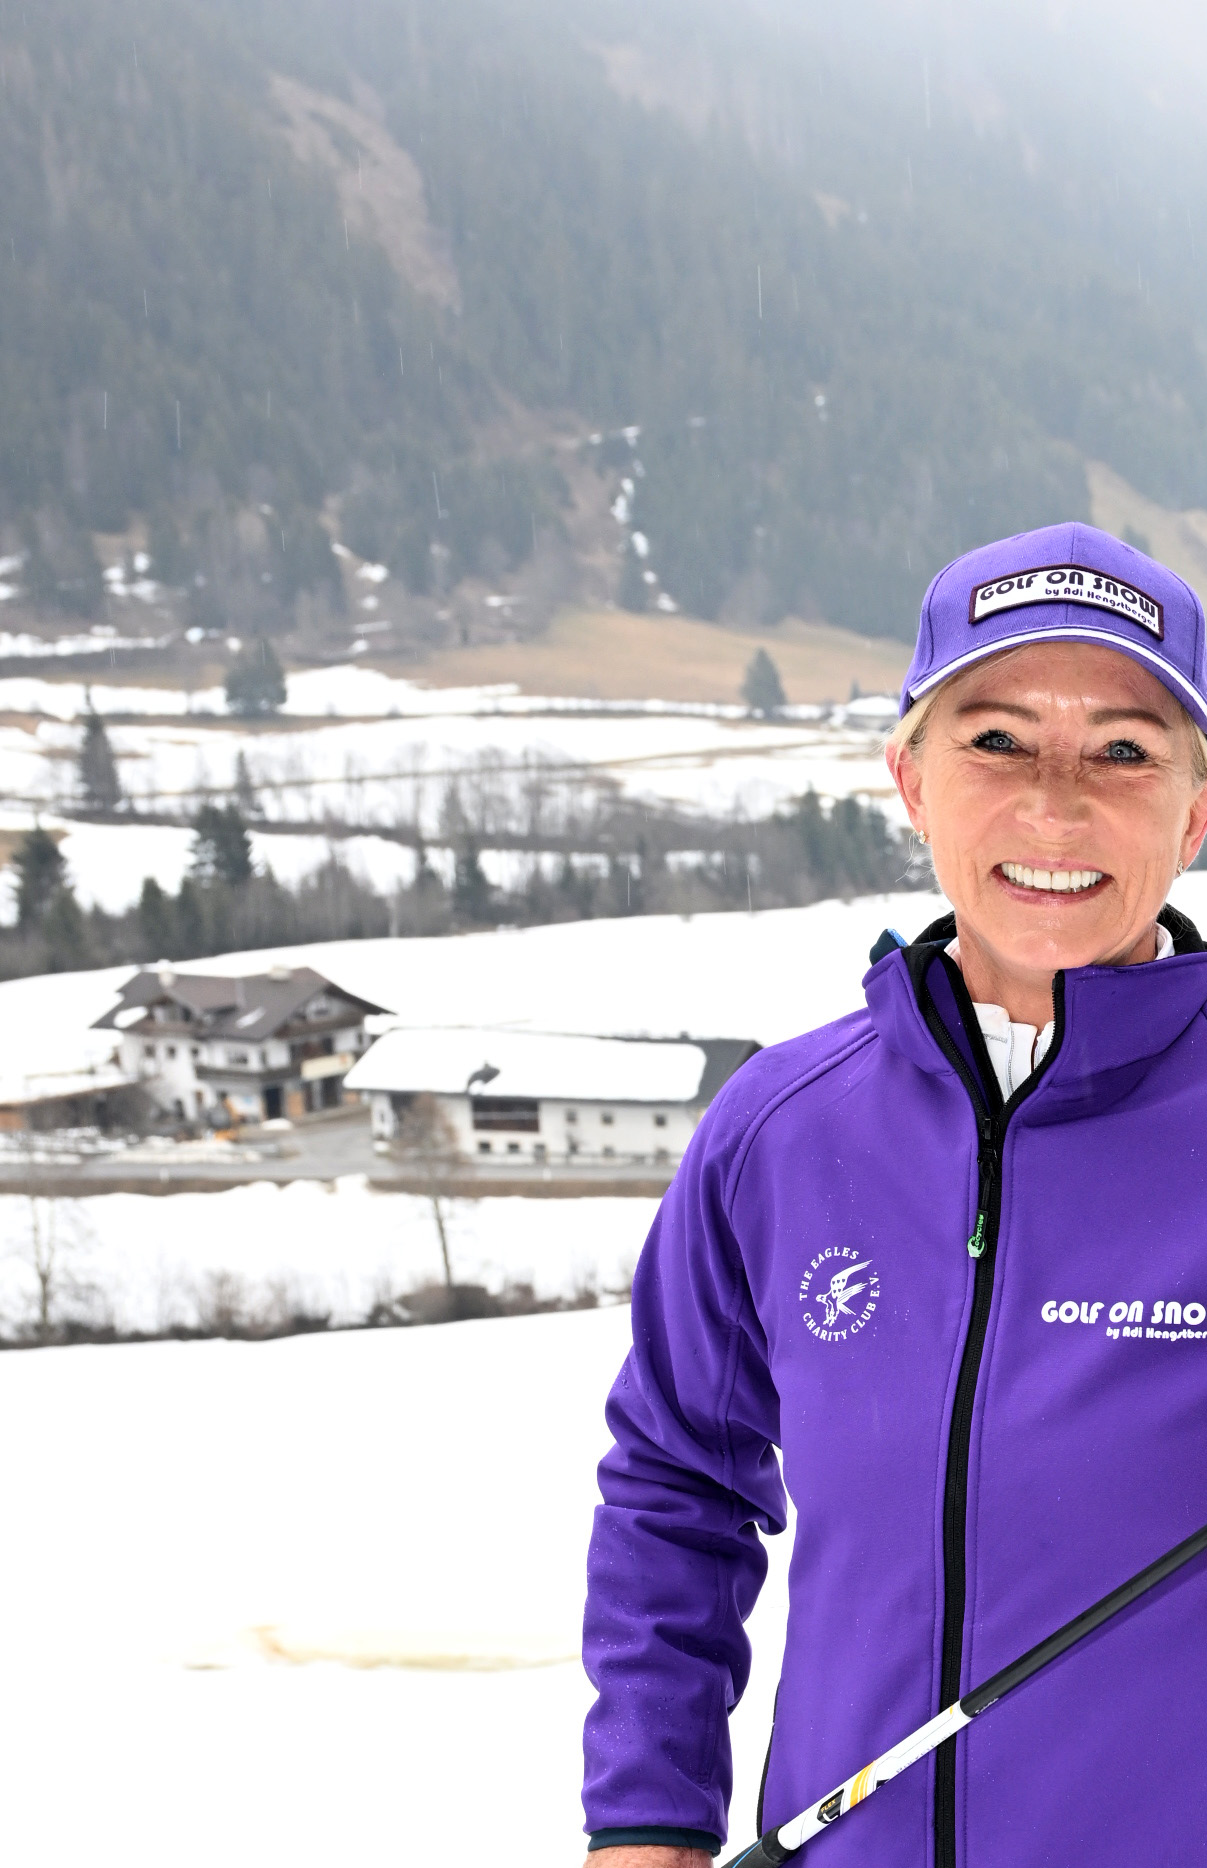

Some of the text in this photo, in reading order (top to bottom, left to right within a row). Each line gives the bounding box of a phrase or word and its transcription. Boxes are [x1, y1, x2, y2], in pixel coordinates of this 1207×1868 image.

[980, 571, 1156, 618] GOLF ON SNOW
[1045, 587, 1156, 628] by Adi Hengstberger
[799, 1246, 859, 1301] THE EAGLES
[803, 1312, 847, 1342] CHARITY
[850, 1302, 877, 1334] CLUB
[1041, 1300, 1105, 1324] GOLF
[1109, 1300, 1144, 1323] ON
[1106, 1326, 1120, 1340] by
[1122, 1325, 1143, 1338] Adi
[820, 1798, 836, 1813] FLEX
